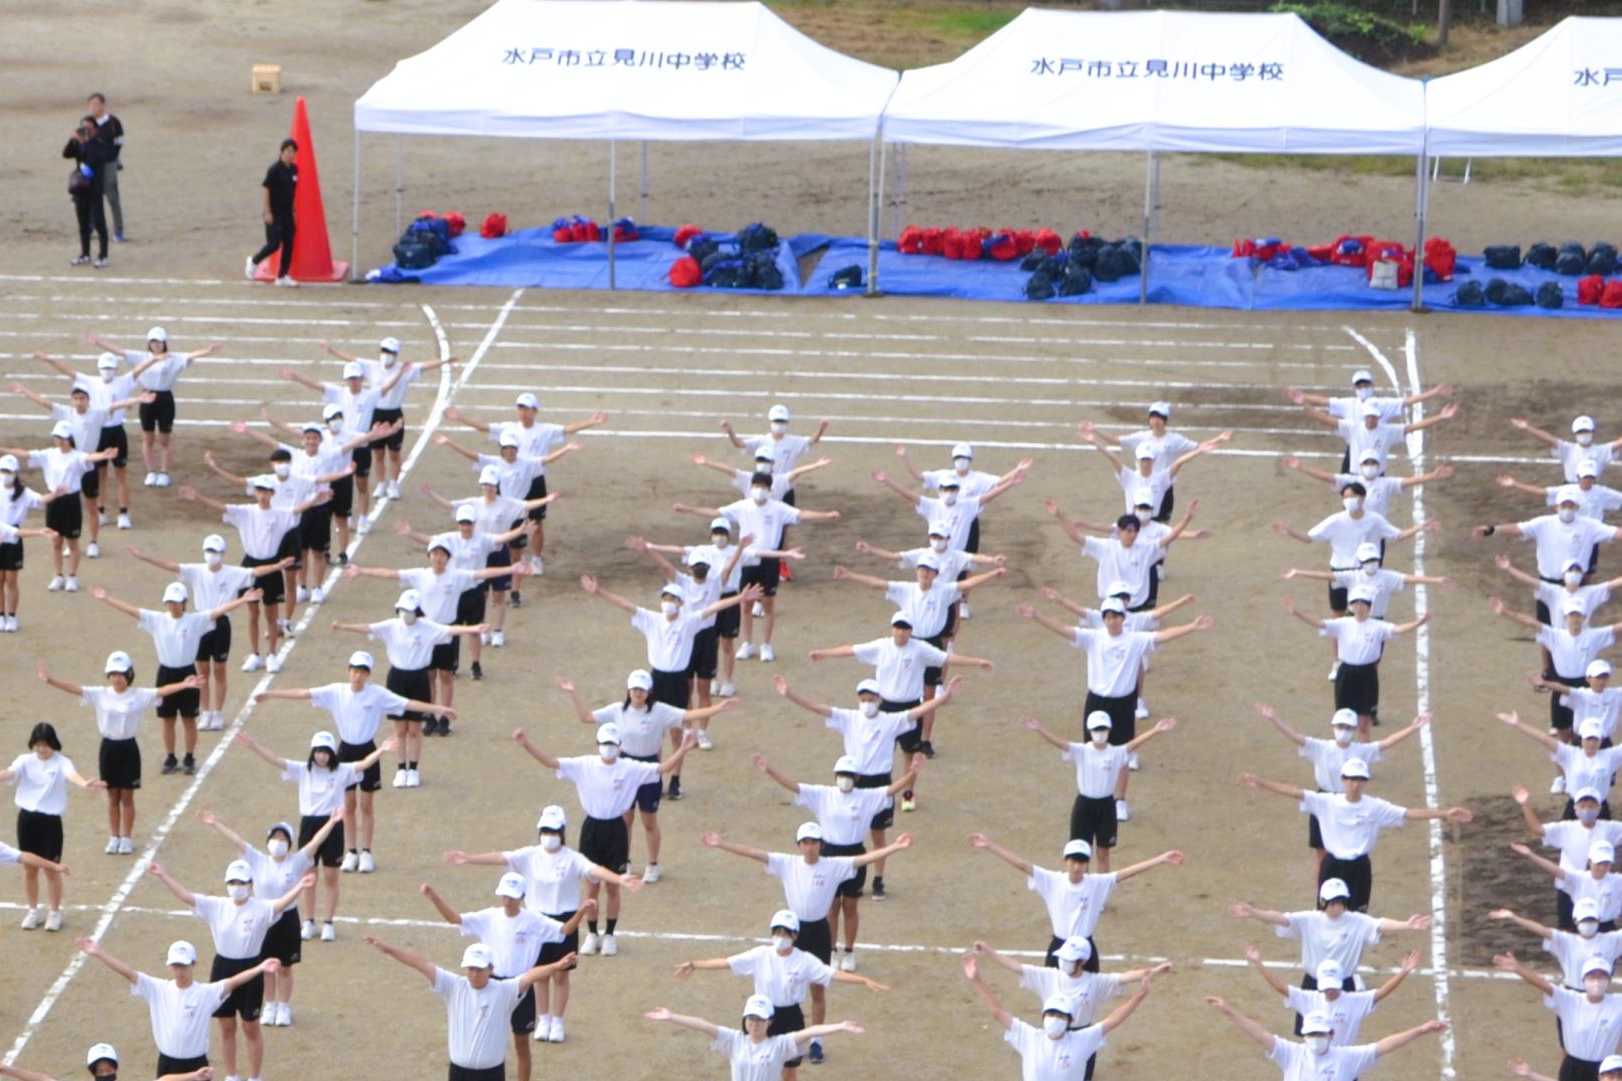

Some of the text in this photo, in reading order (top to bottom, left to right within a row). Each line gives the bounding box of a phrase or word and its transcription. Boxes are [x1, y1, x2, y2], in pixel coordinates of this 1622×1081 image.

[502, 47, 746, 70] 水戸市立見川中学校
[1030, 57, 1284, 81] 水戸市立見川中学校
[1573, 67, 1622, 86] 水戸
